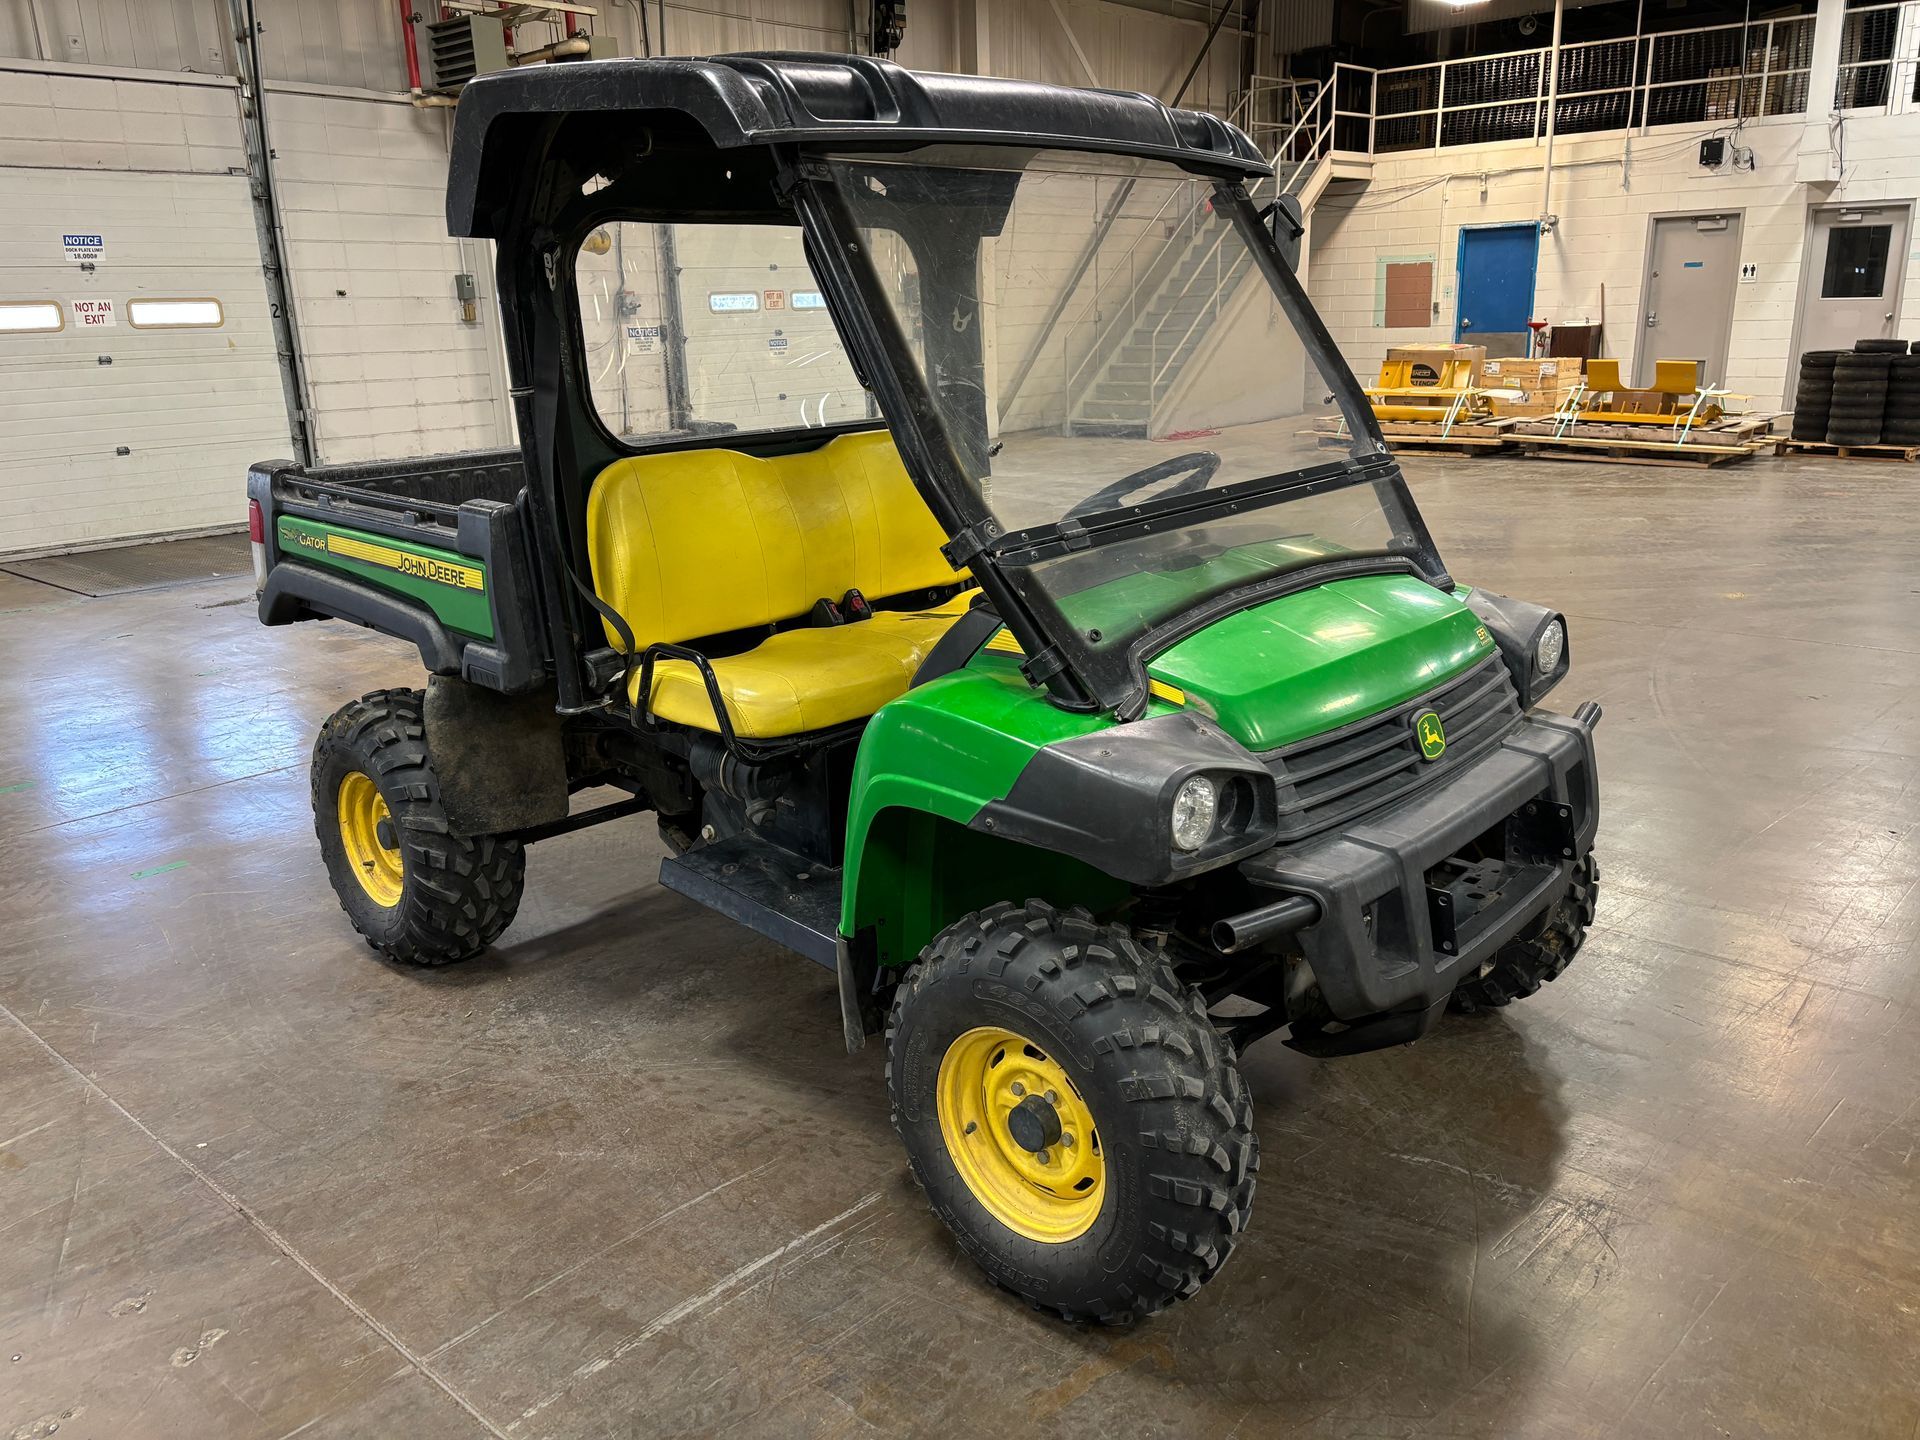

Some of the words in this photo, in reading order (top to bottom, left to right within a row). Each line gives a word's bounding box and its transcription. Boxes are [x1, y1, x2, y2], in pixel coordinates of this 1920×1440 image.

[65, 236, 101, 245] NOTICE
[74, 302, 94, 312] NOT
[97, 302, 111, 312] AN
[270, 303, 281, 318] 2
[84, 314, 106, 325] EXIT
[629, 327, 658, 337] NOTICE
[299, 532, 326, 550] GATOR
[397, 553, 427, 576] JOHN
[428, 560, 466, 586] DEERE
